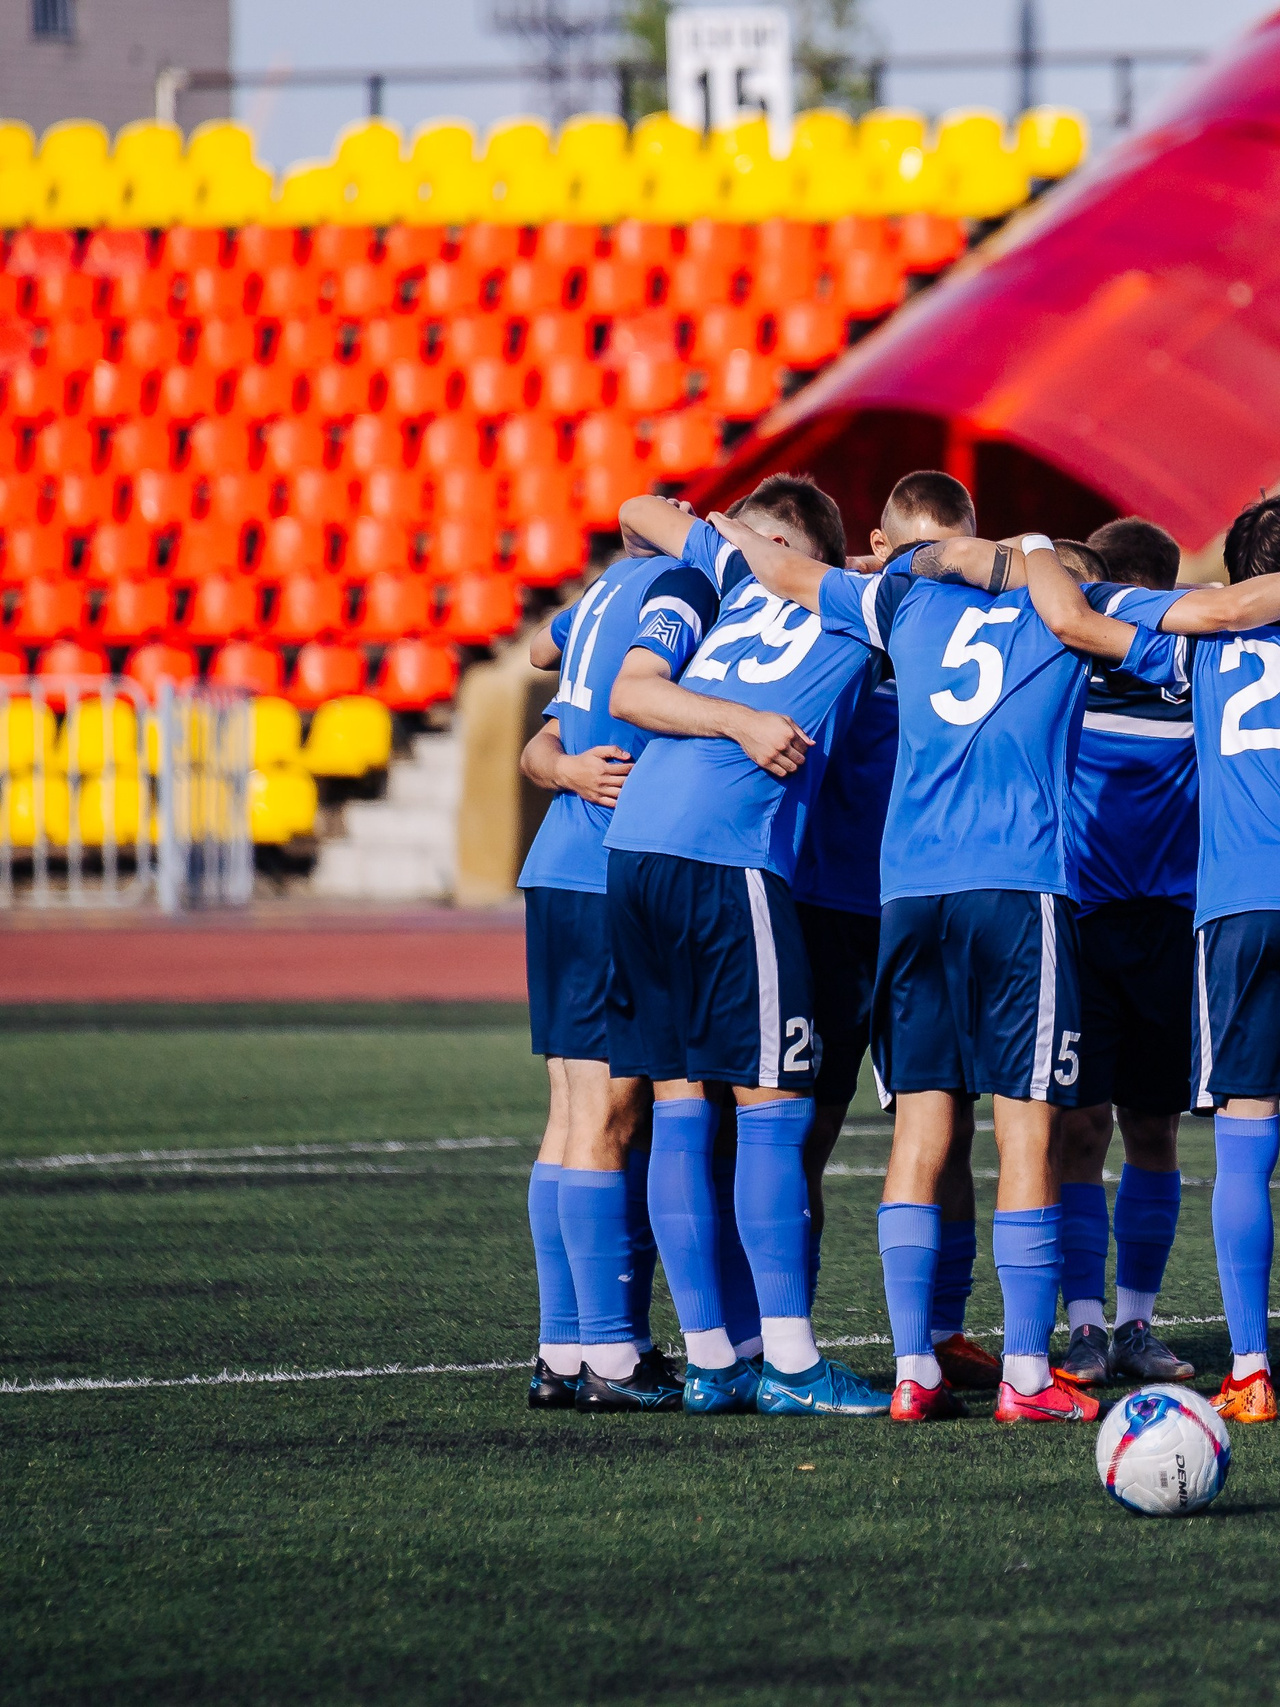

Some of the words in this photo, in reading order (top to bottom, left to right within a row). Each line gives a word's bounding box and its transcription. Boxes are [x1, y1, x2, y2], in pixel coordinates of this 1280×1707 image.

[557, 580, 622, 712] 11
[686, 583, 822, 684] 29
[930, 606, 1022, 727] 5
[783, 1016, 816, 1072] 2
[1054, 1030, 1082, 1086] 5
[1175, 1453, 1188, 1508] DEMIX
